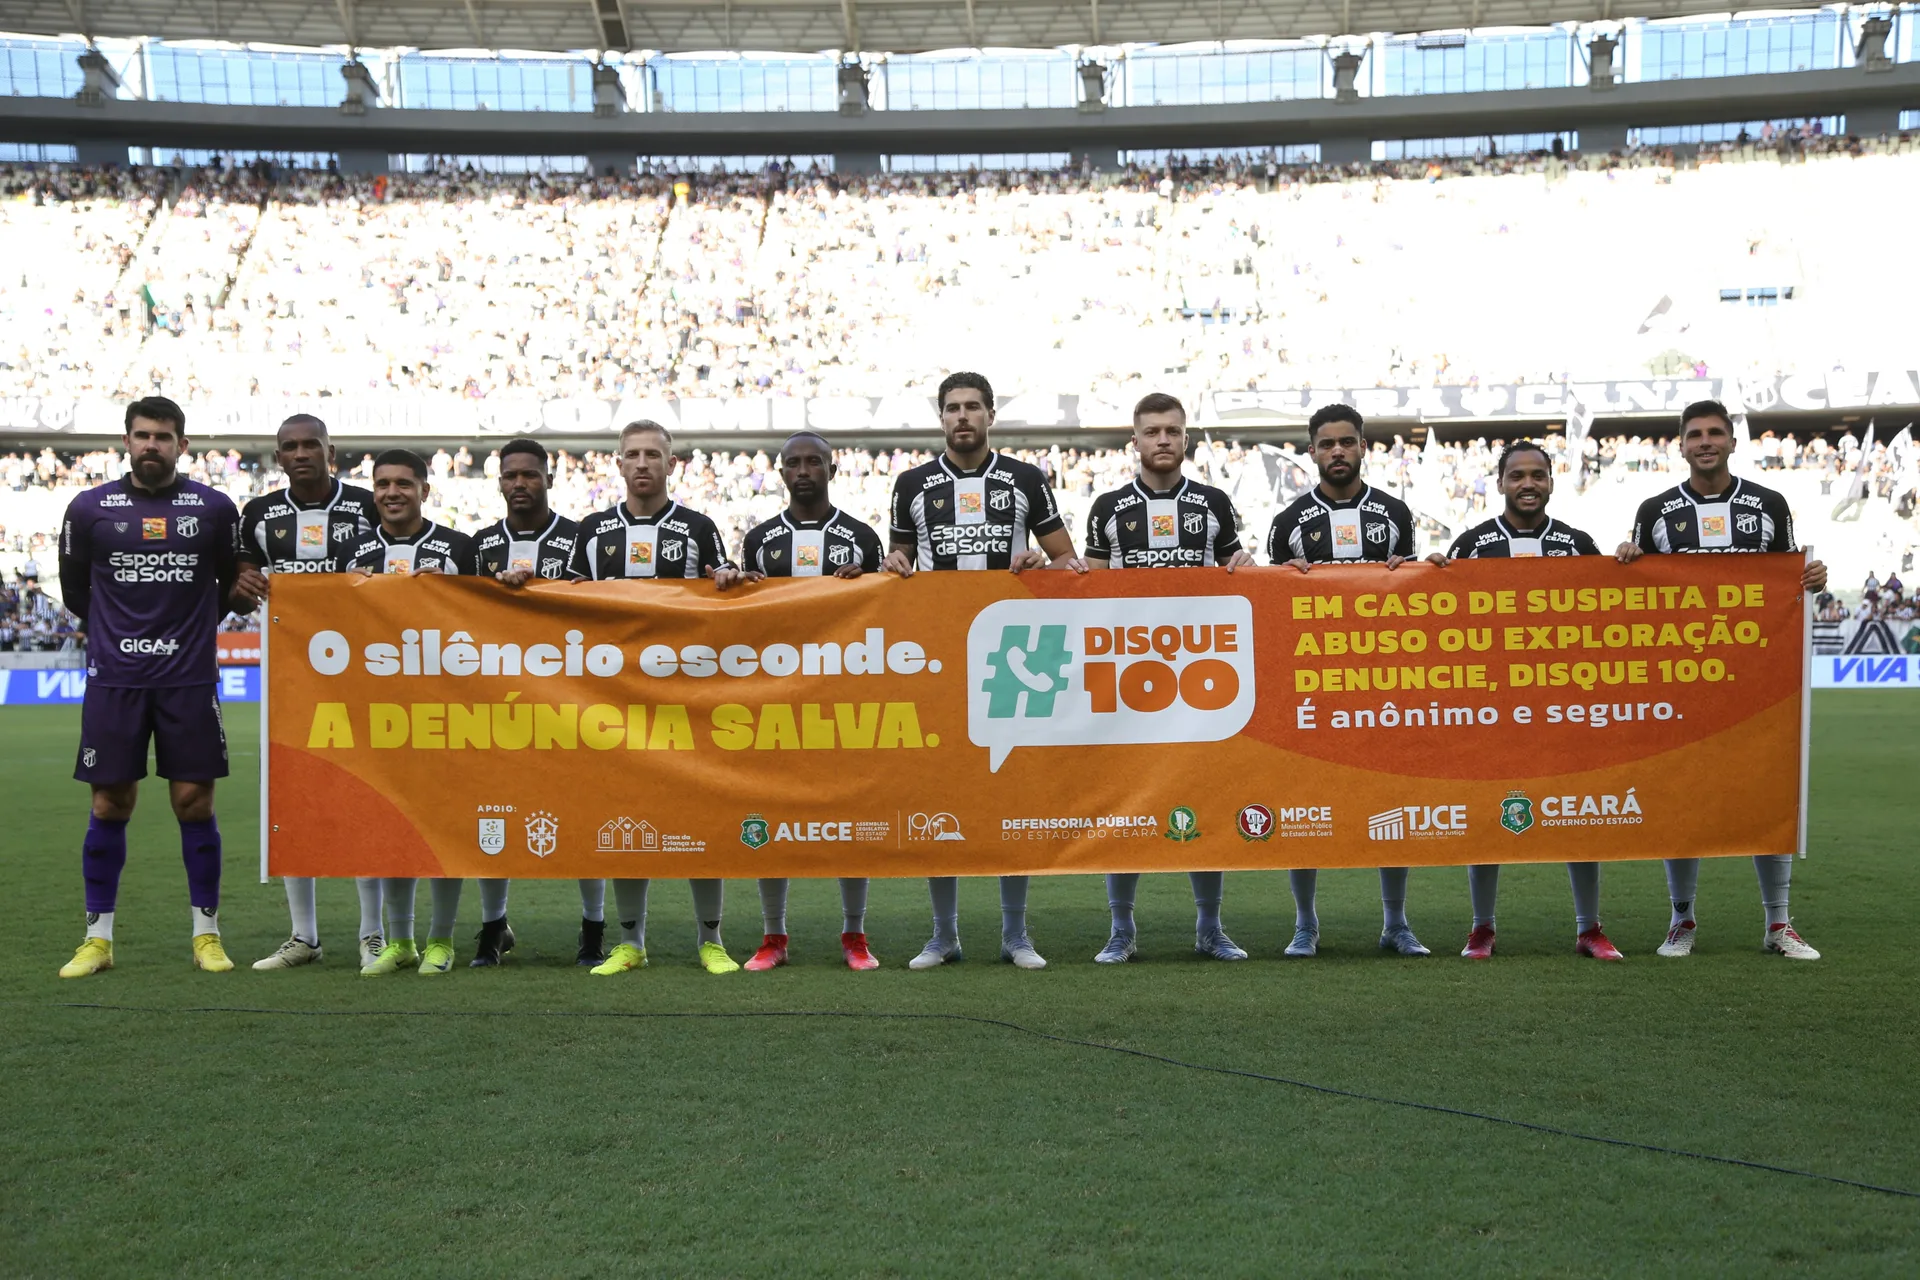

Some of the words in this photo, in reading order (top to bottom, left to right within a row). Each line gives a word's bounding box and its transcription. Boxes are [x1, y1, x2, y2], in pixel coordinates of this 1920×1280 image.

[930, 524, 1013, 542] Esportes
[109, 551, 199, 569] Esportes
[1125, 547, 1203, 565] Esportes
[1292, 595, 1343, 619] EM
[1354, 592, 1457, 617] CASO
[1469, 590, 1516, 614] DE
[1526, 586, 1706, 613] SUSPEITA
[1717, 584, 1764, 608] DE
[1083, 624, 1238, 661] DISQUE
[1294, 629, 1427, 656] ABUSO
[1438, 628, 1492, 652] OU
[1504, 614, 1768, 654] EXPLORAÇÃO,
[308, 630, 350, 675] O
[365, 629, 623, 676] silêncio
[639, 628, 942, 677] esconde.
[1294, 664, 1498, 692] DENUNCIE,
[1509, 660, 1649, 690] DISQUE
[1658, 658, 1735, 683] 100.
[1833, 657, 1908, 683] VIVA
[1084, 658, 1239, 713] 100
[307, 703, 354, 748] A
[369, 691, 694, 750] DENÚNCIA
[711, 703, 940, 750] SALVA.
[1296, 698, 1316, 729] É
[1330, 702, 1499, 728] anônimo
[1513, 705, 1532, 724] e
[1546, 702, 1683, 728] seguro.
[1280, 806, 1332, 822] MPCE
[1540, 787, 1642, 817] CEARÁ
[1002, 817, 1093, 830] DEFENSORIA
[1097, 814, 1158, 828] PÚBLICA
[1403, 805, 1467, 830] TJCE
[1541, 818, 1588, 827] GOVERNO
[1590, 818, 1604, 826] DO
[1606, 817, 1643, 825] ESTADO
[481, 837, 501, 845] FCF
[774, 822, 852, 842] ALECE
[1002, 831, 1021, 840] DO
[1027, 830, 1081, 840] ESTADO
[1087, 829, 1107, 839] DO
[1113, 827, 1158, 838] CEARÁ
